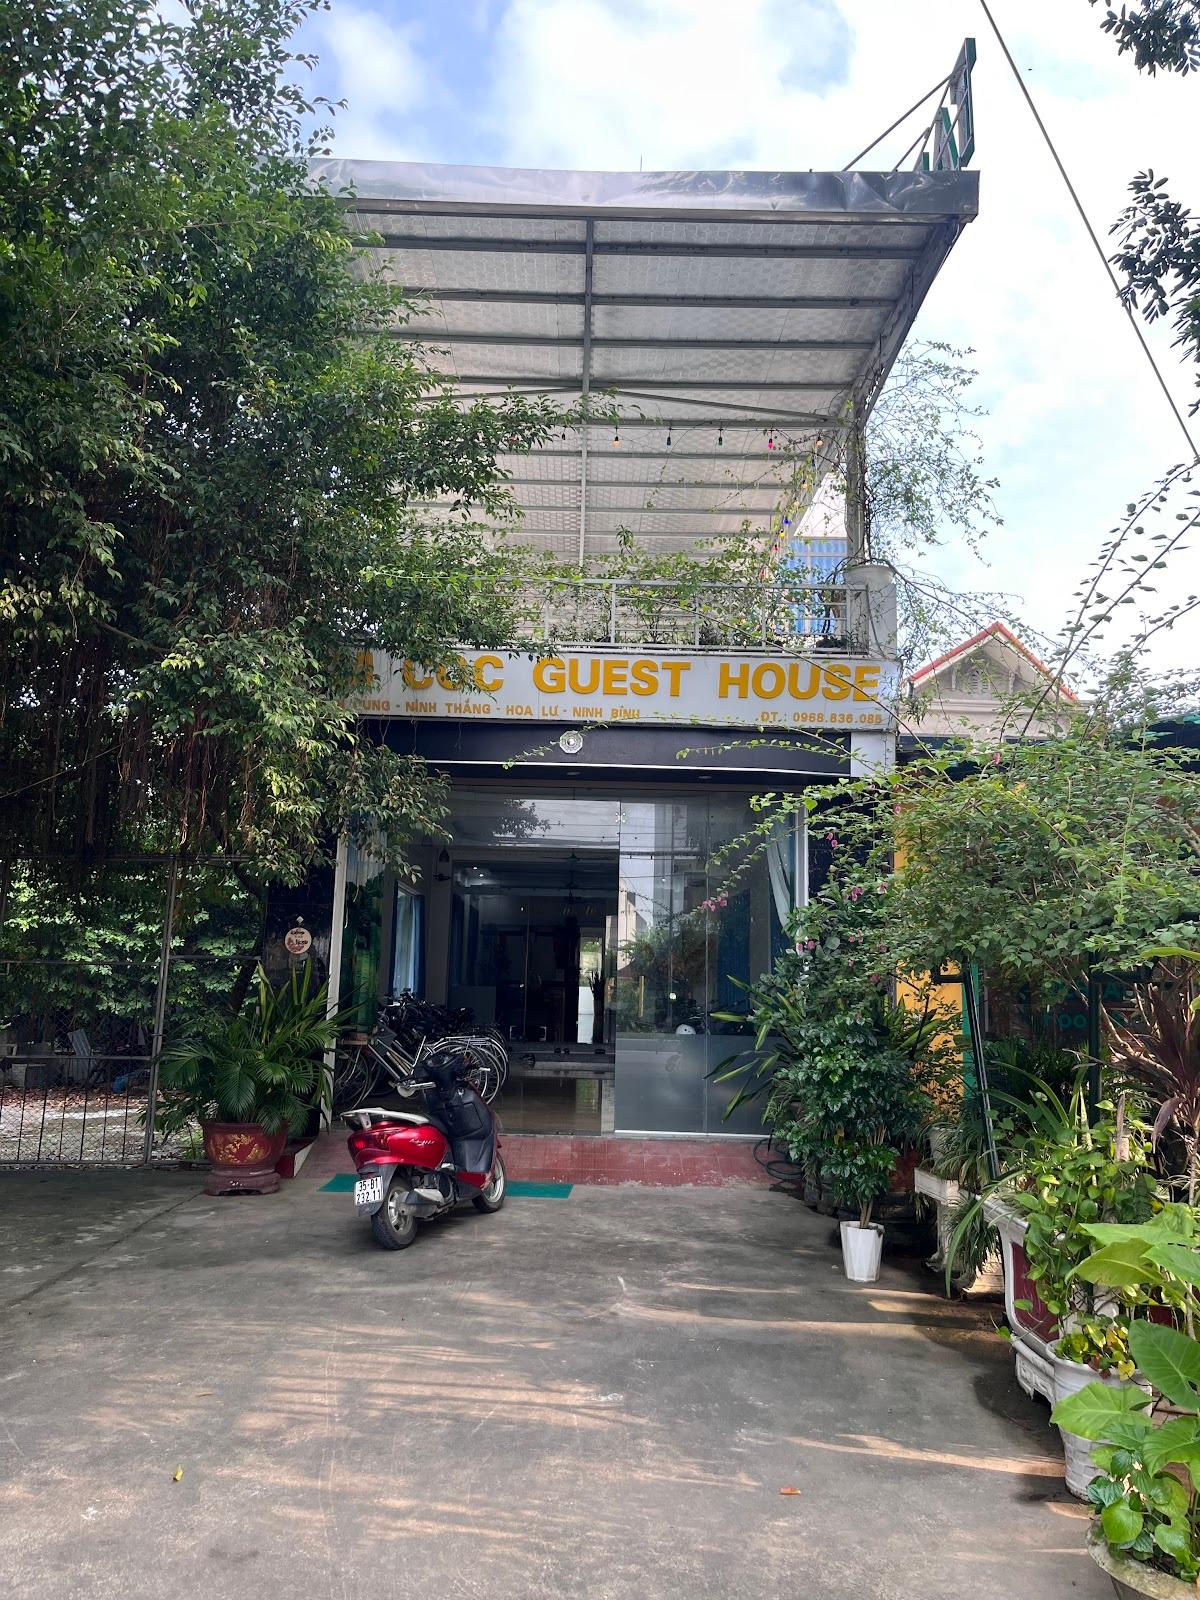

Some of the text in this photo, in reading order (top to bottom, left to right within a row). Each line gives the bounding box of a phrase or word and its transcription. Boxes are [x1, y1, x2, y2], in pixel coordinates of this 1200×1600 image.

[533, 656, 692, 697] GUEST
[718, 662, 881, 702] HOUSE
[506, 704, 534, 716] HOA
[572, 705, 603, 718] NINH
